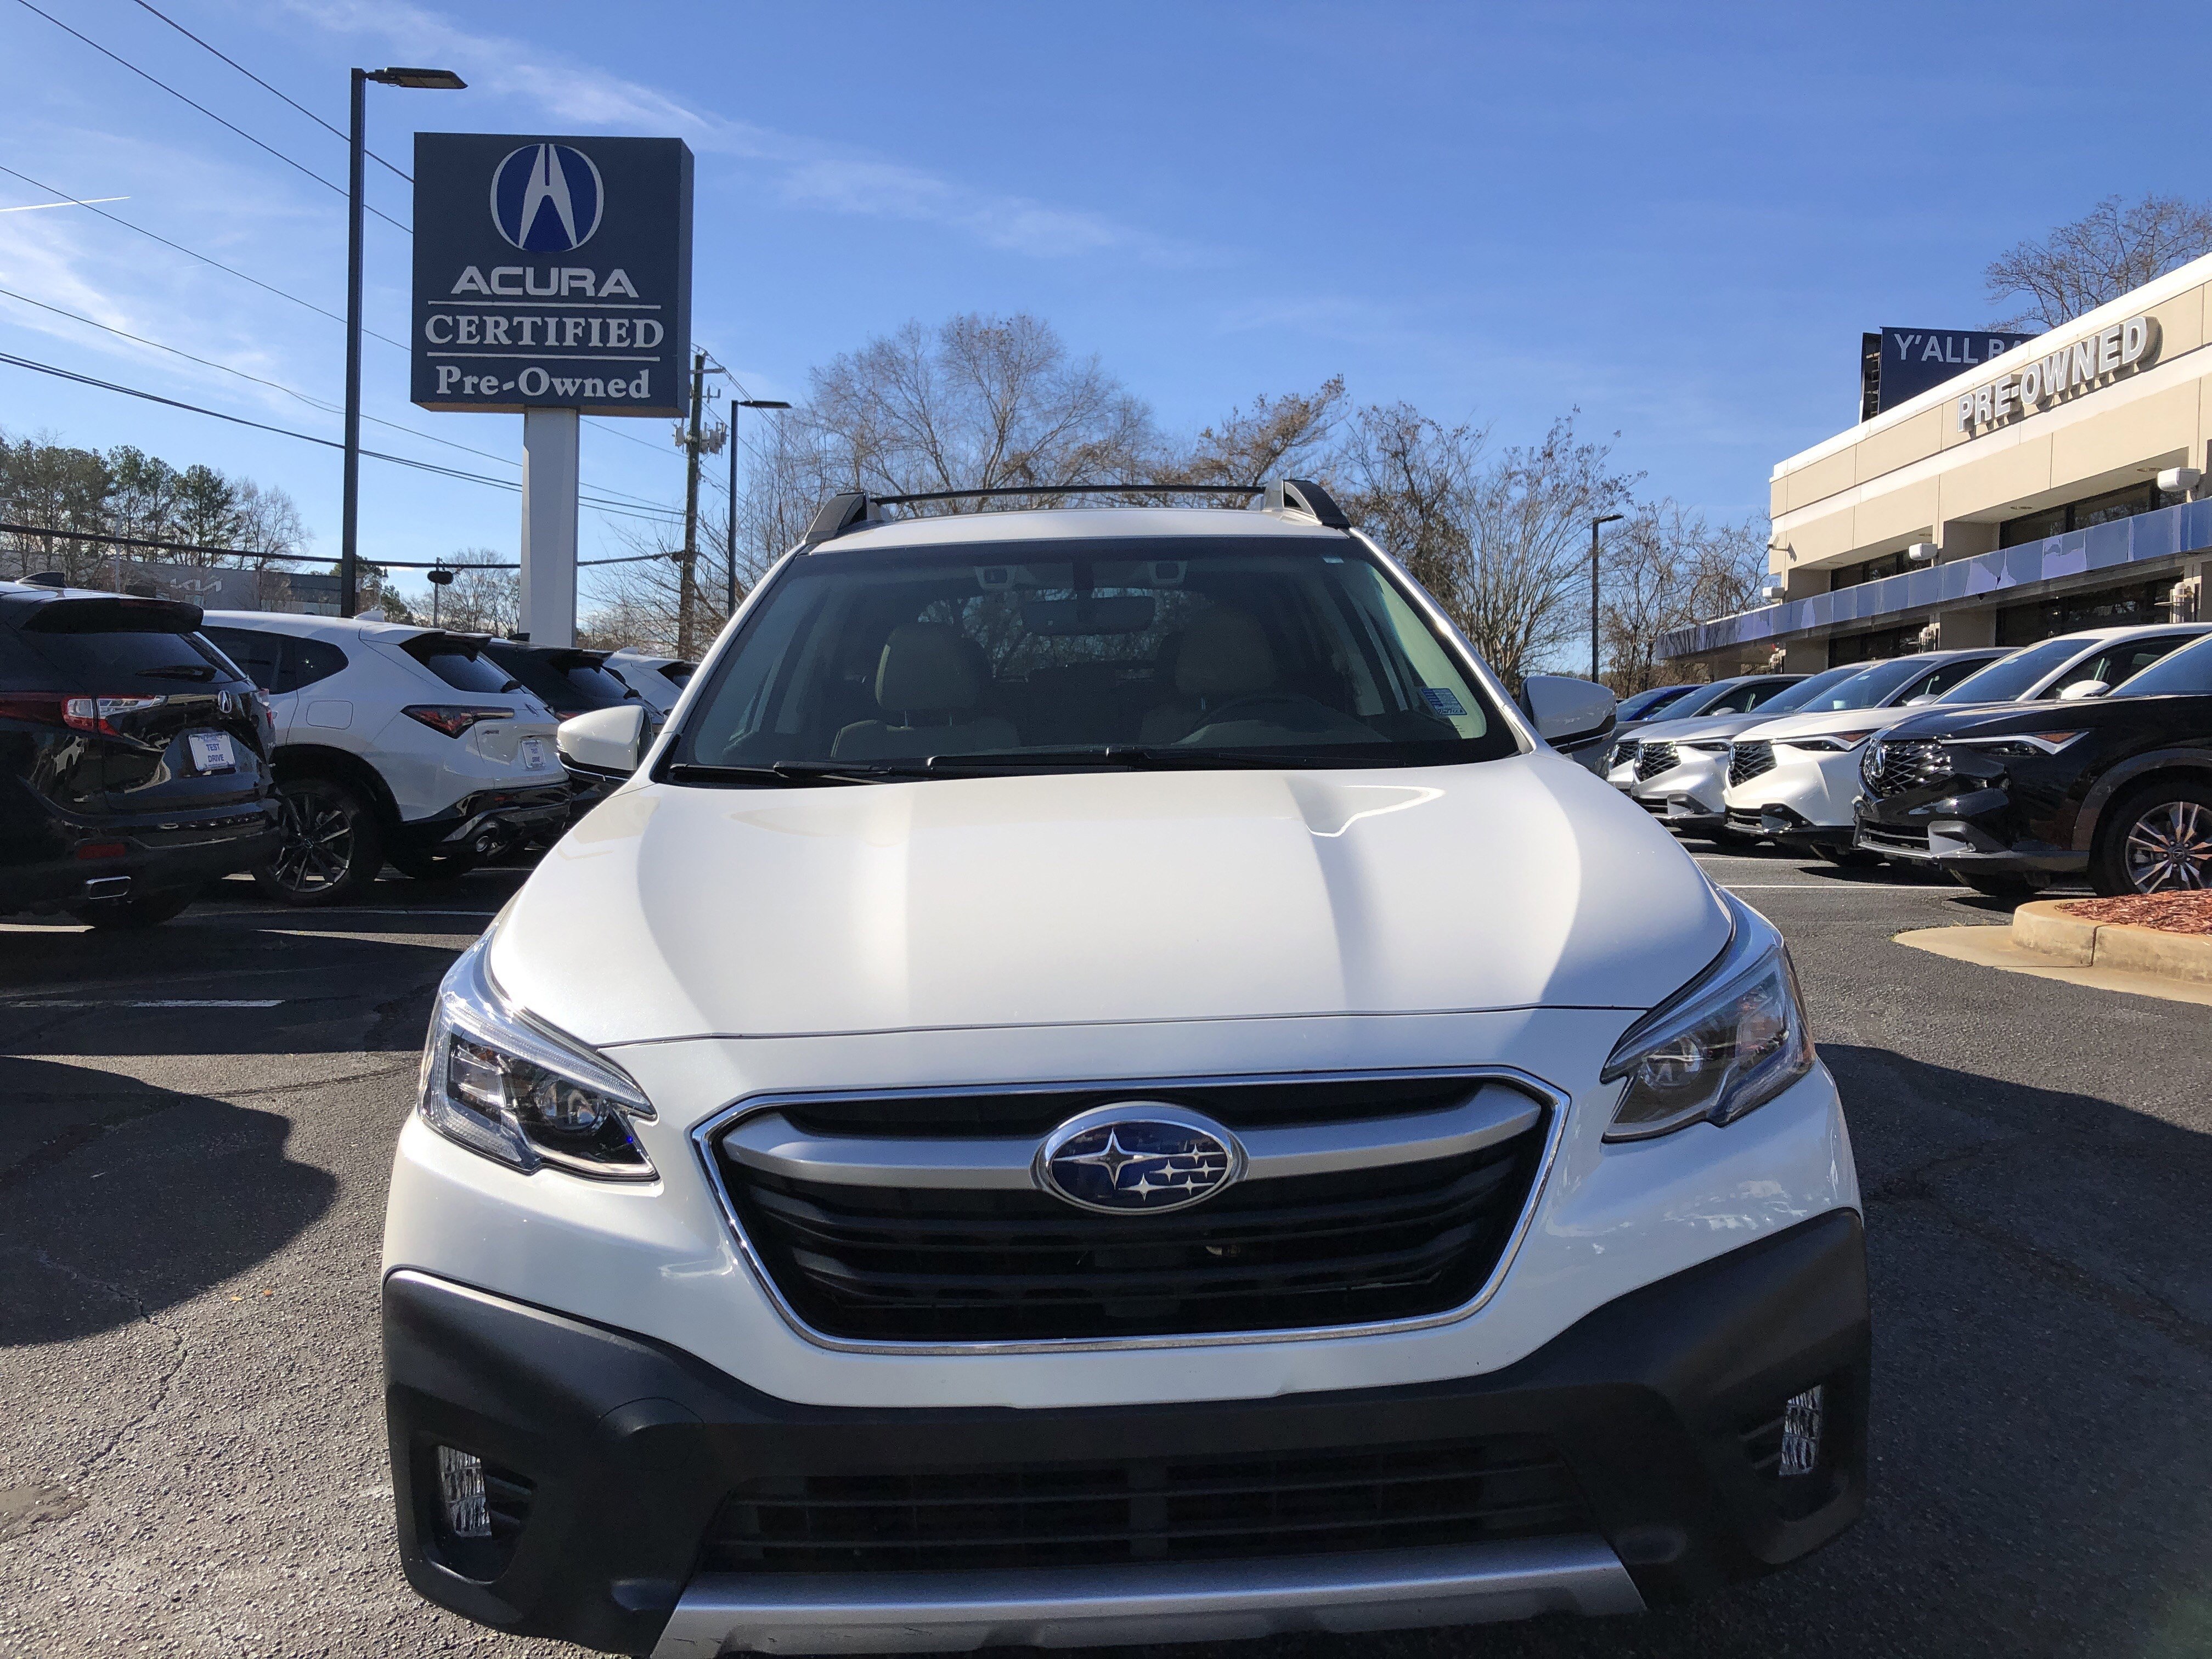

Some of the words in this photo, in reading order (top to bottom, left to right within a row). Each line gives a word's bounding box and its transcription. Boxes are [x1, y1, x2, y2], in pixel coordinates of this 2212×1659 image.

[450, 266, 639, 298] ACURA
[425, 314, 664, 349] CERTIFIED
[1894, 334, 1979, 364] Y'ALL
[436, 365, 651, 399] Pre-Owned
[1957, 315, 2148, 433] PRE-OWNED
[206, 743, 221, 752] TEST
[207, 754, 224, 763] DRIVE
